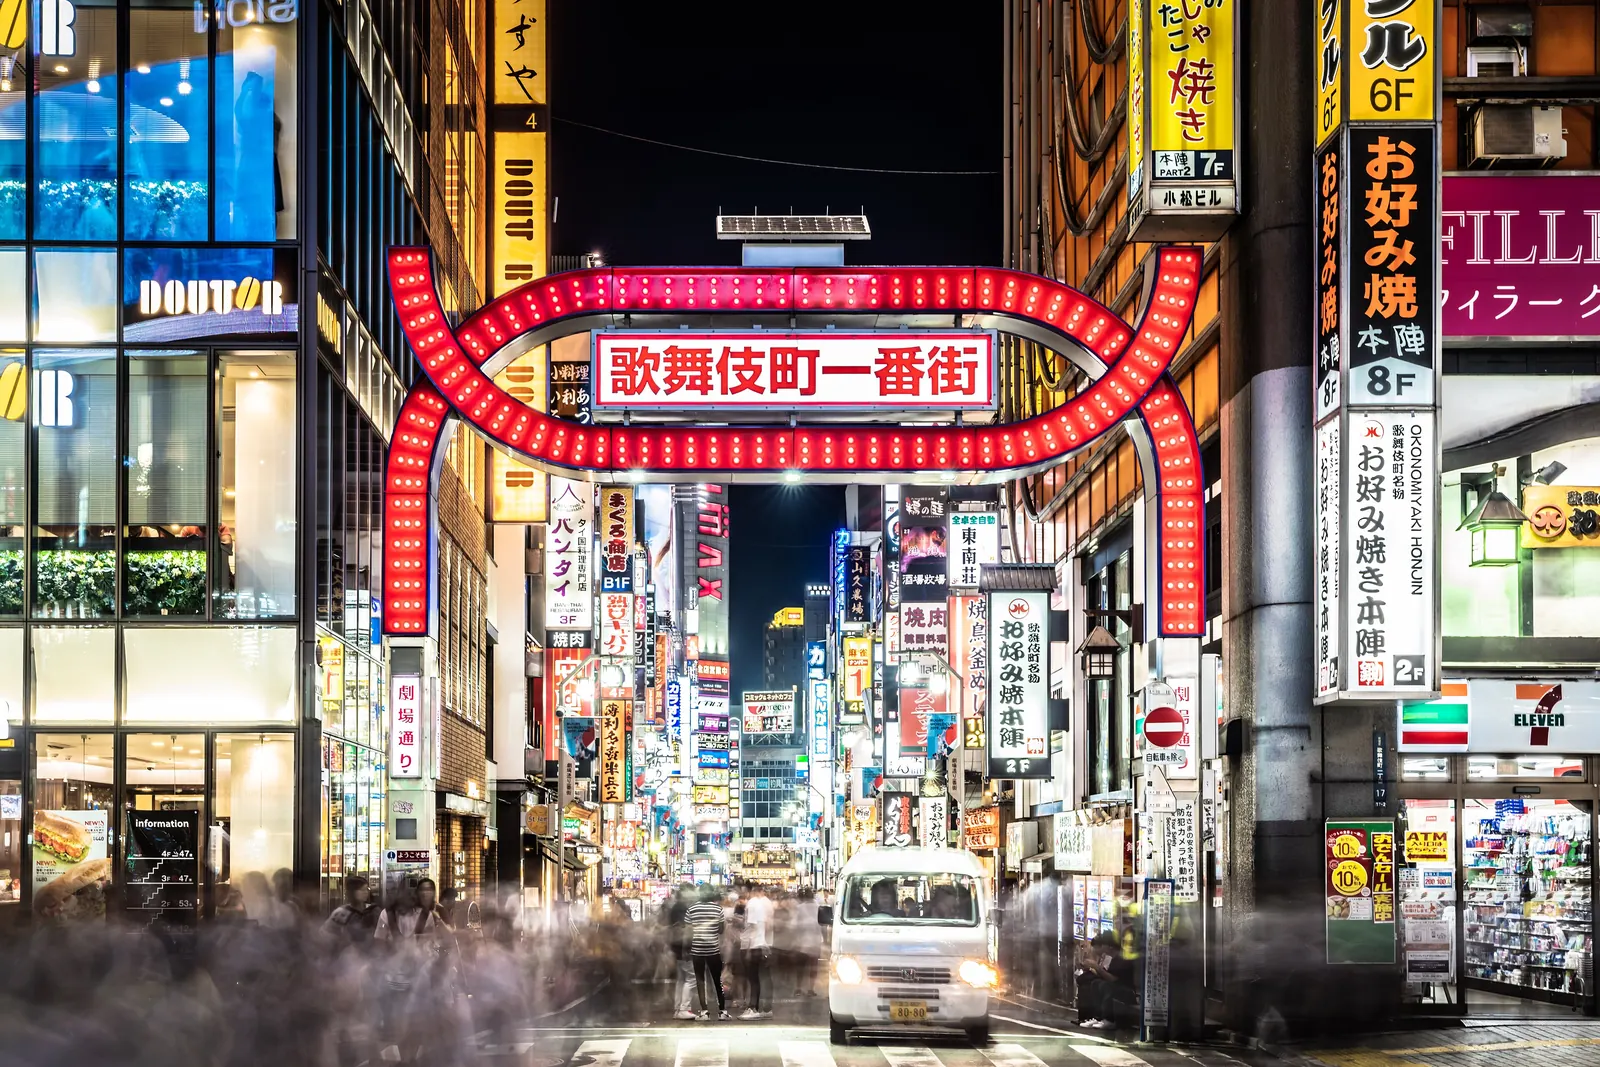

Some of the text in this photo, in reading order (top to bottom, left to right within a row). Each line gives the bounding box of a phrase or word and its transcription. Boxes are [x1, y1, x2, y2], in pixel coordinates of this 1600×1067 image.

[1369, 77, 1415, 112] 6F
[525, 112, 538, 129] 4
[1323, 88, 1337, 132] 6F
[1160, 152, 1188, 167] 本陣
[1160, 166, 1191, 177] PART2
[1199, 152, 1225, 177] 7F
[1163, 190, 1222, 207] 小松ビル
[1364, 136, 1418, 319] お好み焼
[1321, 152, 1339, 336] お好み焼
[140, 276, 283, 316] DOUTOR
[1320, 333, 1340, 371] 本陣
[1357, 322, 1426, 356] 本陣
[610, 345, 979, 396] 歌舞伎町一番街
[1366, 365, 1416, 396] 8F
[1324, 376, 1337, 408] 8F
[1391, 424, 1405, 500] 歌舞伎町名物
[952, 515, 996, 525] 全卓全自動
[1410, 424, 1423, 596] OKONOMIYAKI HONJIN
[607, 492, 627, 572] まぐろ商店
[551, 518, 574, 597] バンタイ
[577, 518, 588, 592] タイ国料理専門店
[961, 527, 977, 584] 東南荘
[1355, 445, 1386, 658] お好み焼き本陣
[603, 577, 630, 589] B1F
[902, 574, 946, 585] 酒場牧場
[559, 615, 577, 624] 3F
[904, 607, 947, 628] 焼肉
[553, 632, 585, 648] 焼肉
[848, 648, 867, 657] 麻雀
[1027, 623, 1040, 684] 歌舞伎町名物
[850, 669, 862, 696] 1
[999, 620, 1025, 749] お好み焼本陣
[1395, 658, 1425, 682] 2F
[609, 688, 626, 698] 4F
[398, 685, 415, 769] 劇場通り
[1514, 713, 1564, 727] ELEVEN
[1006, 758, 1031, 774] 2F
[1146, 752, 1182, 762] 自転車を除く
[1376, 789, 1386, 797] 17
[135, 819, 189, 828] information
[1407, 832, 1447, 841] ATM
[1176, 807, 1188, 886] 防犯カメラ作動中
[1185, 803, 1196, 891] みなさまの安全を守ります
[1337, 842, 1350, 856] 10
[1373, 833, 1392, 863] おでん
[1337, 870, 1353, 887] 10
[1374, 863, 1392, 893] セール
